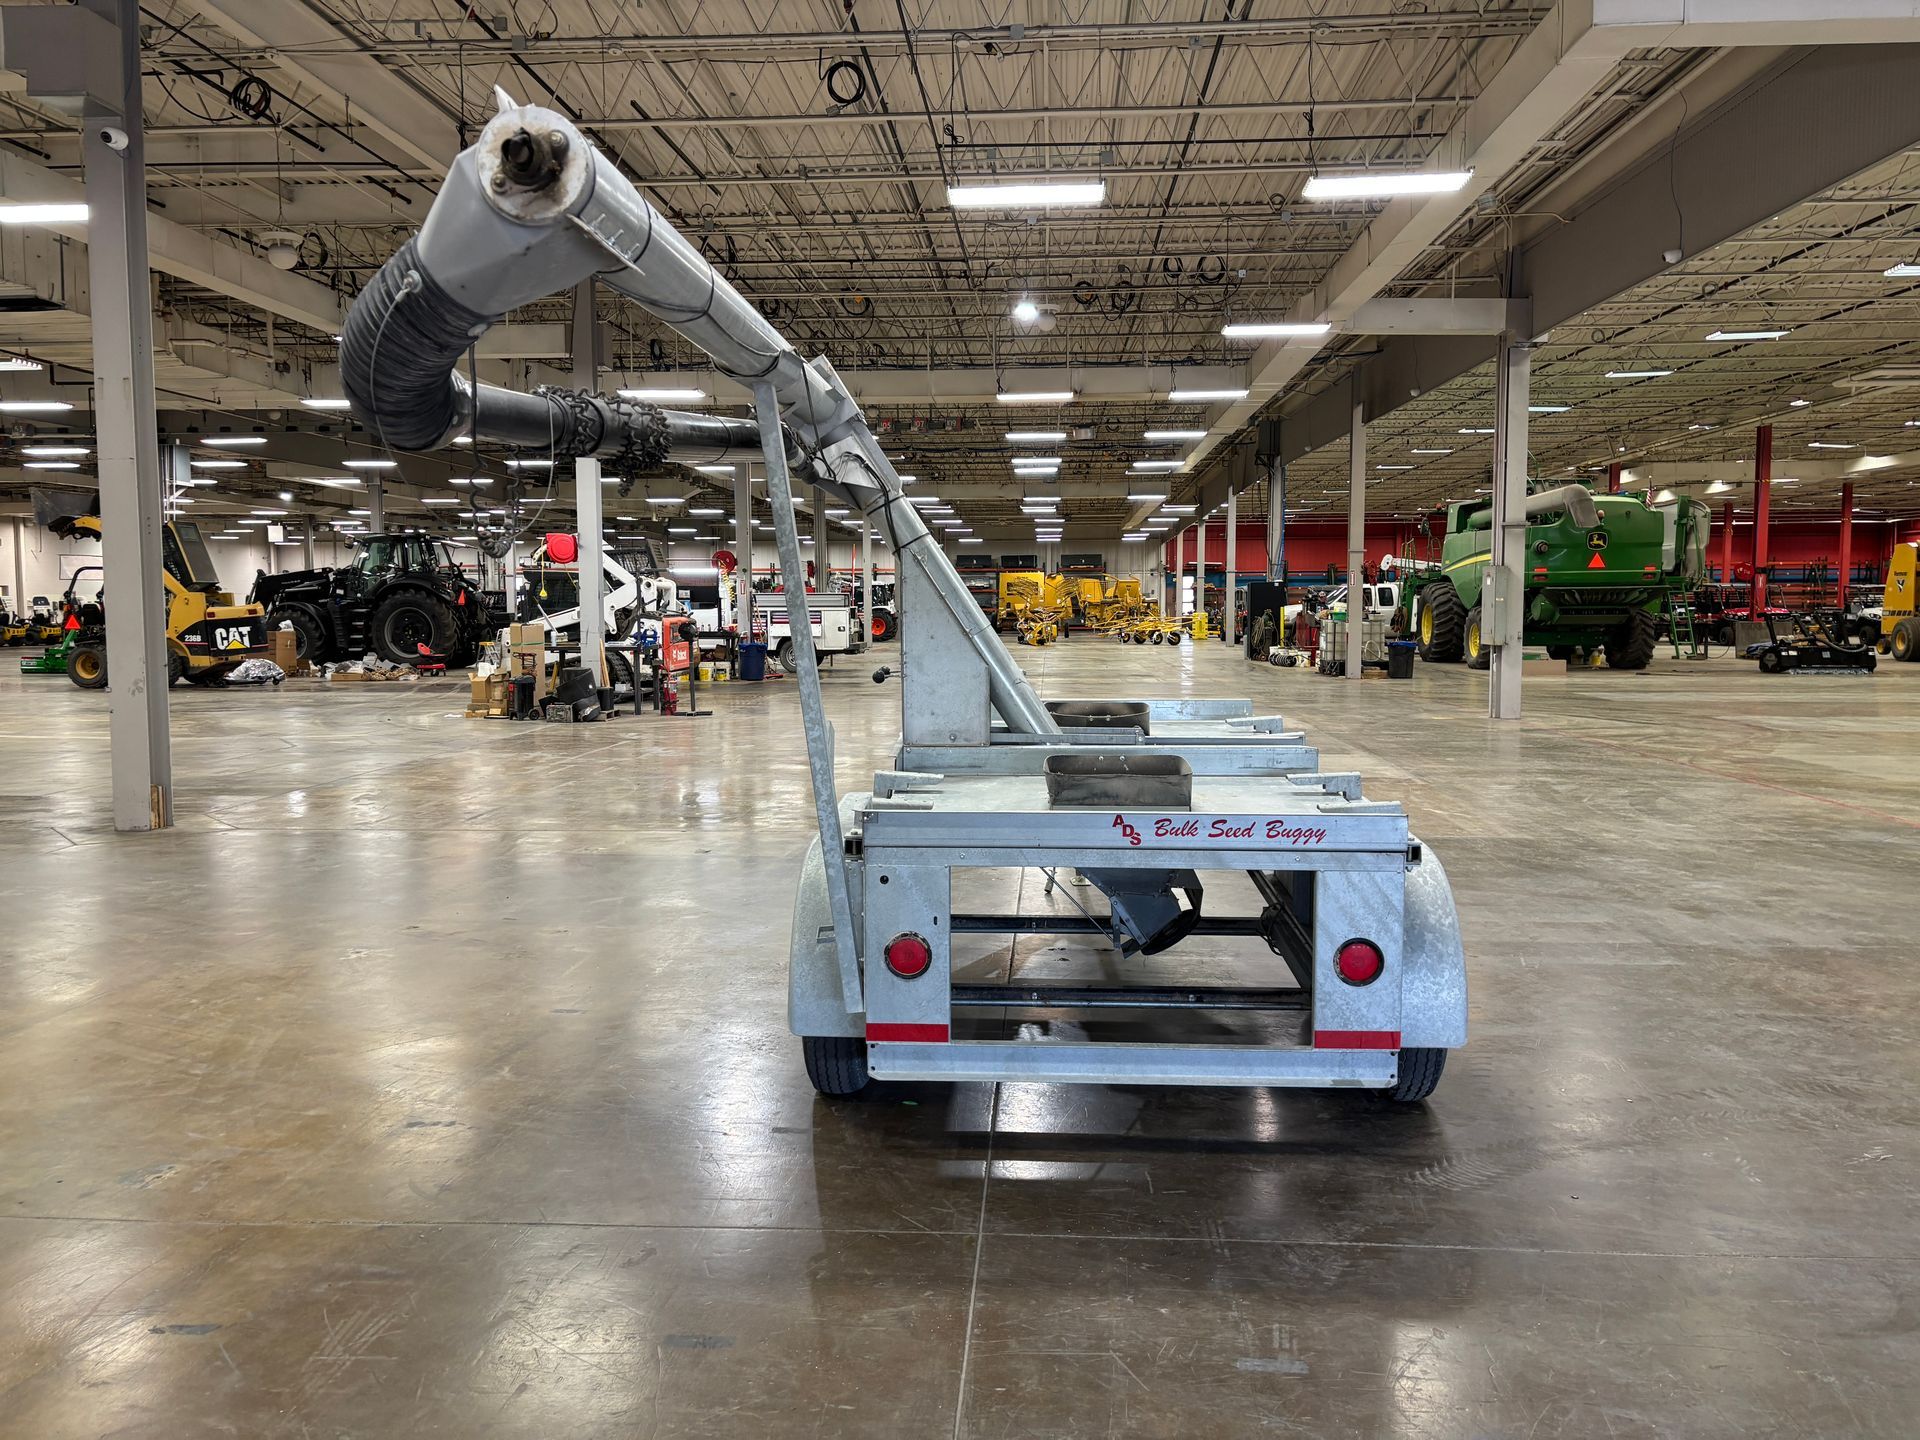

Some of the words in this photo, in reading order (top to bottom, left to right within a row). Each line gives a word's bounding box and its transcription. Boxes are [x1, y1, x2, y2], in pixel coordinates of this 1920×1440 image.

[184, 634, 202, 642] 236B
[214, 626, 252, 650] CAT
[1112, 814, 1142, 846] ADS
[1154, 818, 1199, 837] Bulk
[1208, 819, 1256, 838] Seed
[1265, 820, 1327, 845] Buggy
